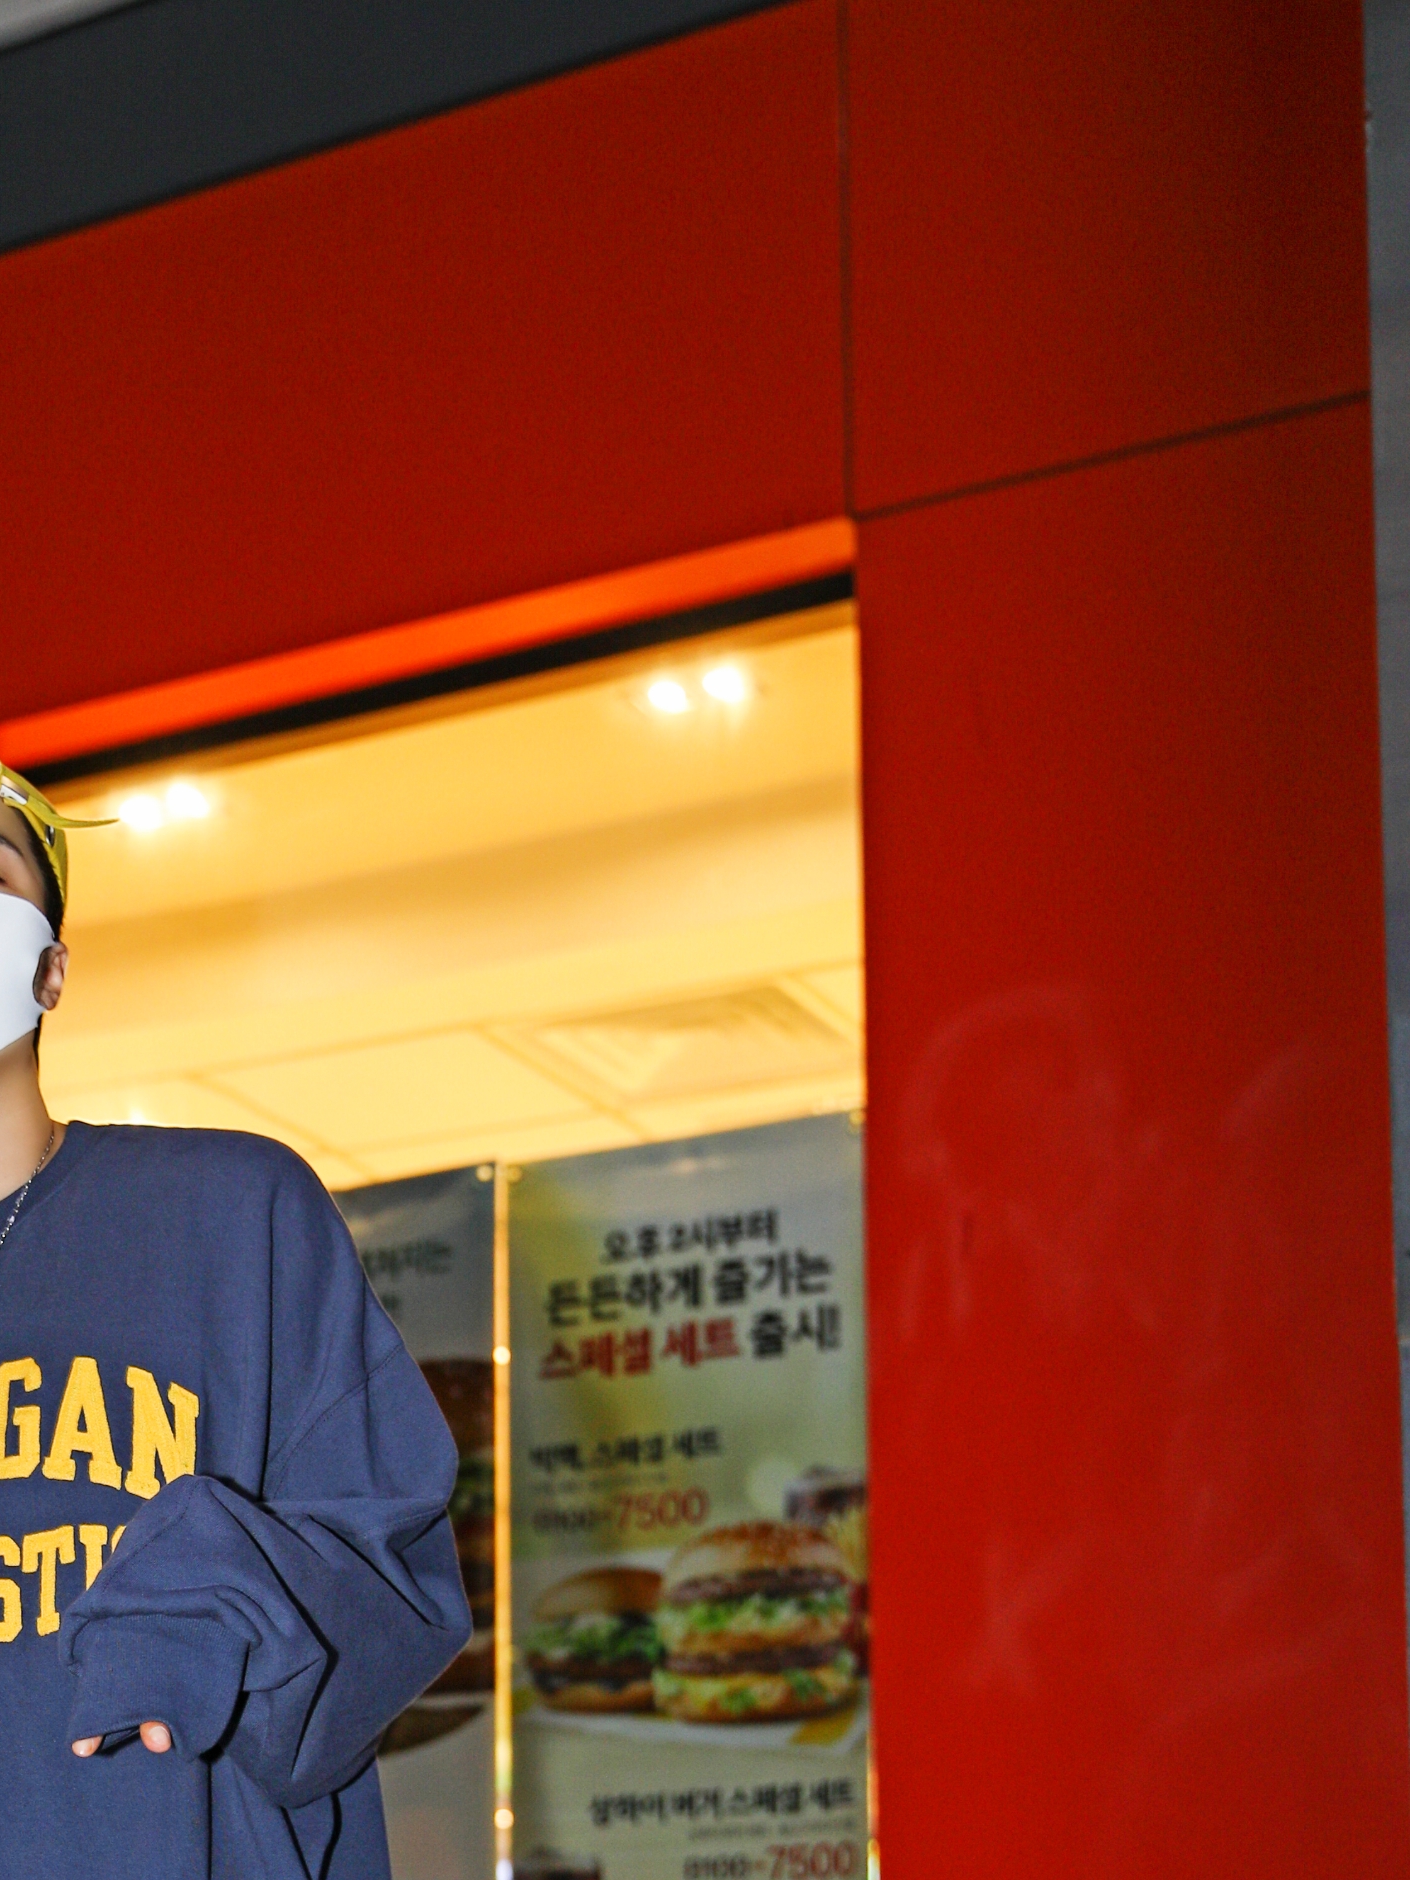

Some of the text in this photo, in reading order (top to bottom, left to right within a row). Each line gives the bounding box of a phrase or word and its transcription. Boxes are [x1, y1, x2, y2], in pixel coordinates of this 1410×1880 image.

[599, 1208, 778, 1265] 오후 2시부터
[546, 1248, 833, 1327] 든든하게 즐기는
[540, 1324, 653, 1379] 스페셜
[662, 1316, 742, 1370] 세트
[614, 1485, 711, 1532] 7500
